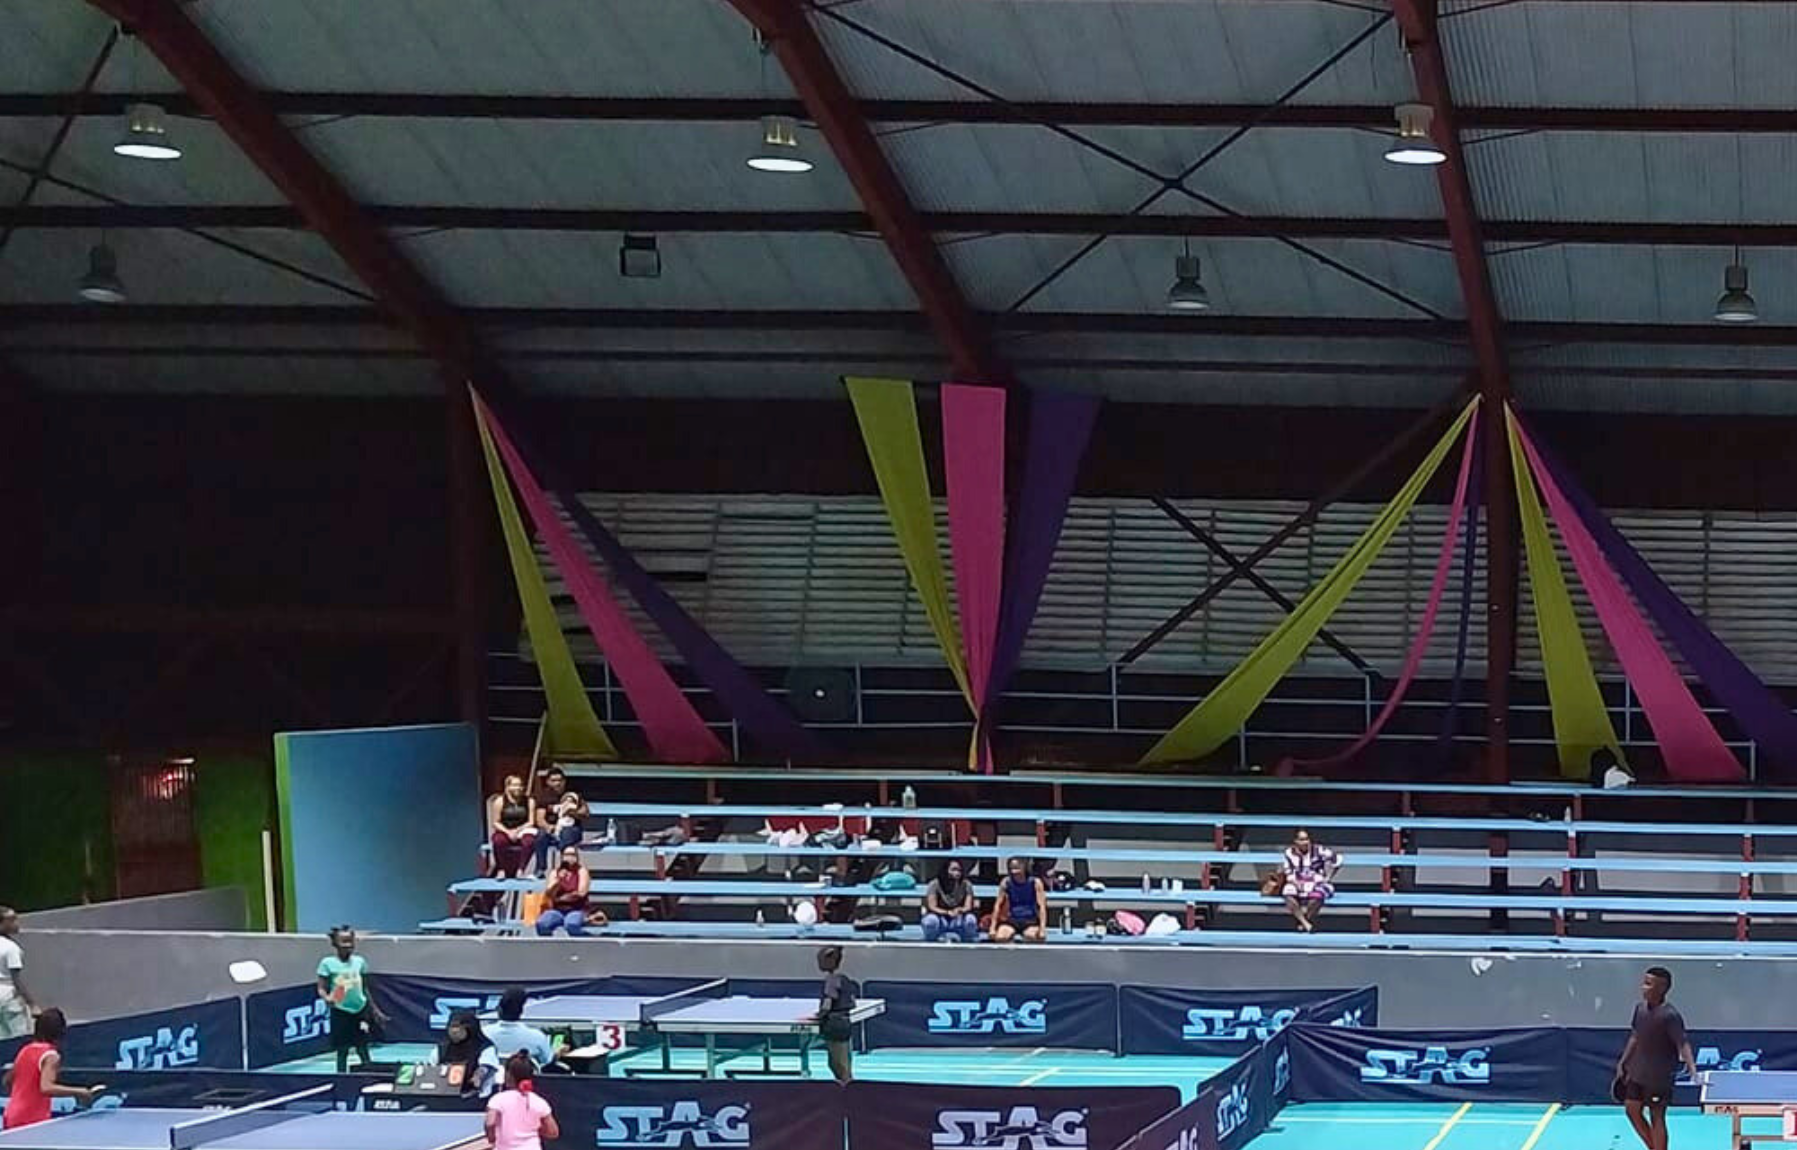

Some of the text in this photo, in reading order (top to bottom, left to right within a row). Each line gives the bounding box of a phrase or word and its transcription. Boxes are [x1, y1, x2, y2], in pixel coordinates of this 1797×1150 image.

[283, 999, 330, 1044] STA
[928, 997, 1046, 1034] STAG
[603, 1025, 622, 1050] 3
[1361, 1046, 1490, 1084] STAG
[596, 1100, 750, 1149] STAG
[1217, 1083, 1249, 1141] STAG
